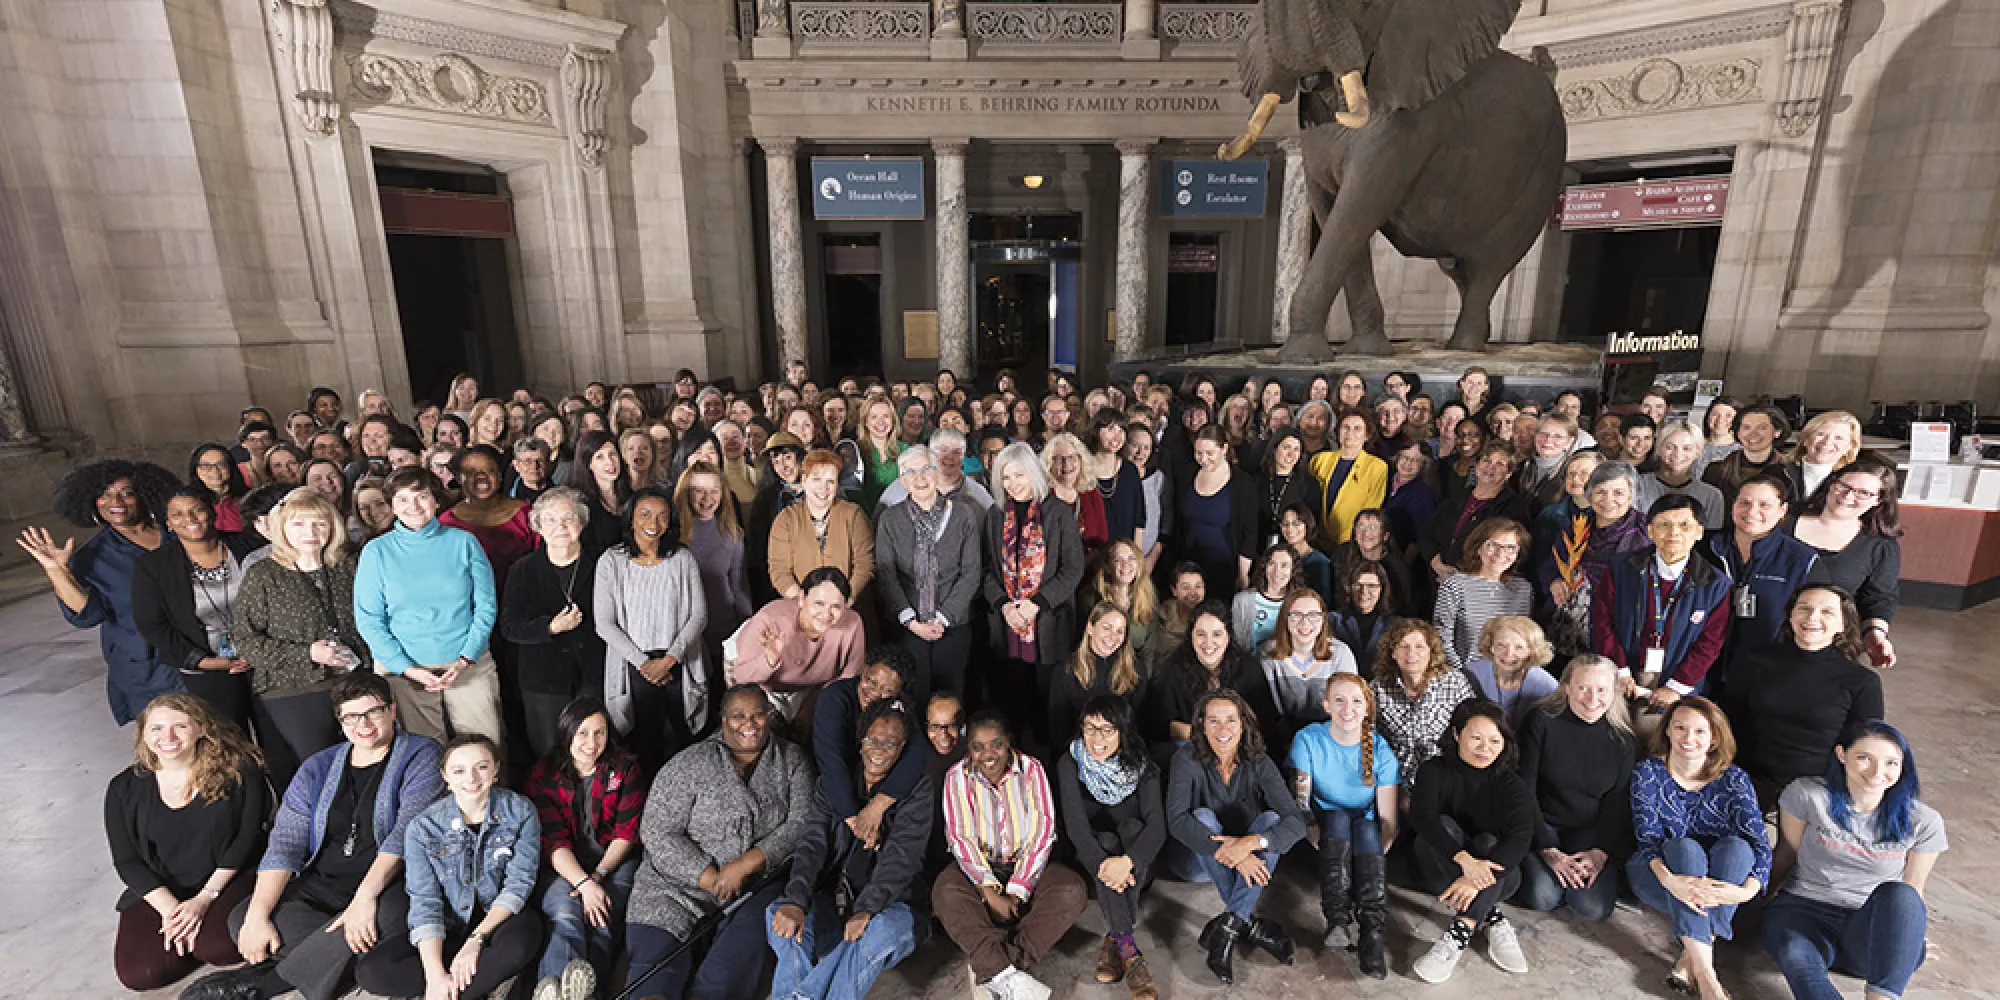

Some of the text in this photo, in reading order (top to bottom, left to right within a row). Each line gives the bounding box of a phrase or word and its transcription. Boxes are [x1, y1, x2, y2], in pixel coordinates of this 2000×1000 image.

[867, 97, 1221, 111] KENNETH E. BEHRING FAMILY ROTUNDA
[846, 171, 899, 182] Ocean Hall
[1207, 173, 1259, 184] Rest Rooms
[847, 189, 917, 203] Human Origins
[1205, 192, 1248, 203] Escalator
[1607, 330, 1699, 353] Information
